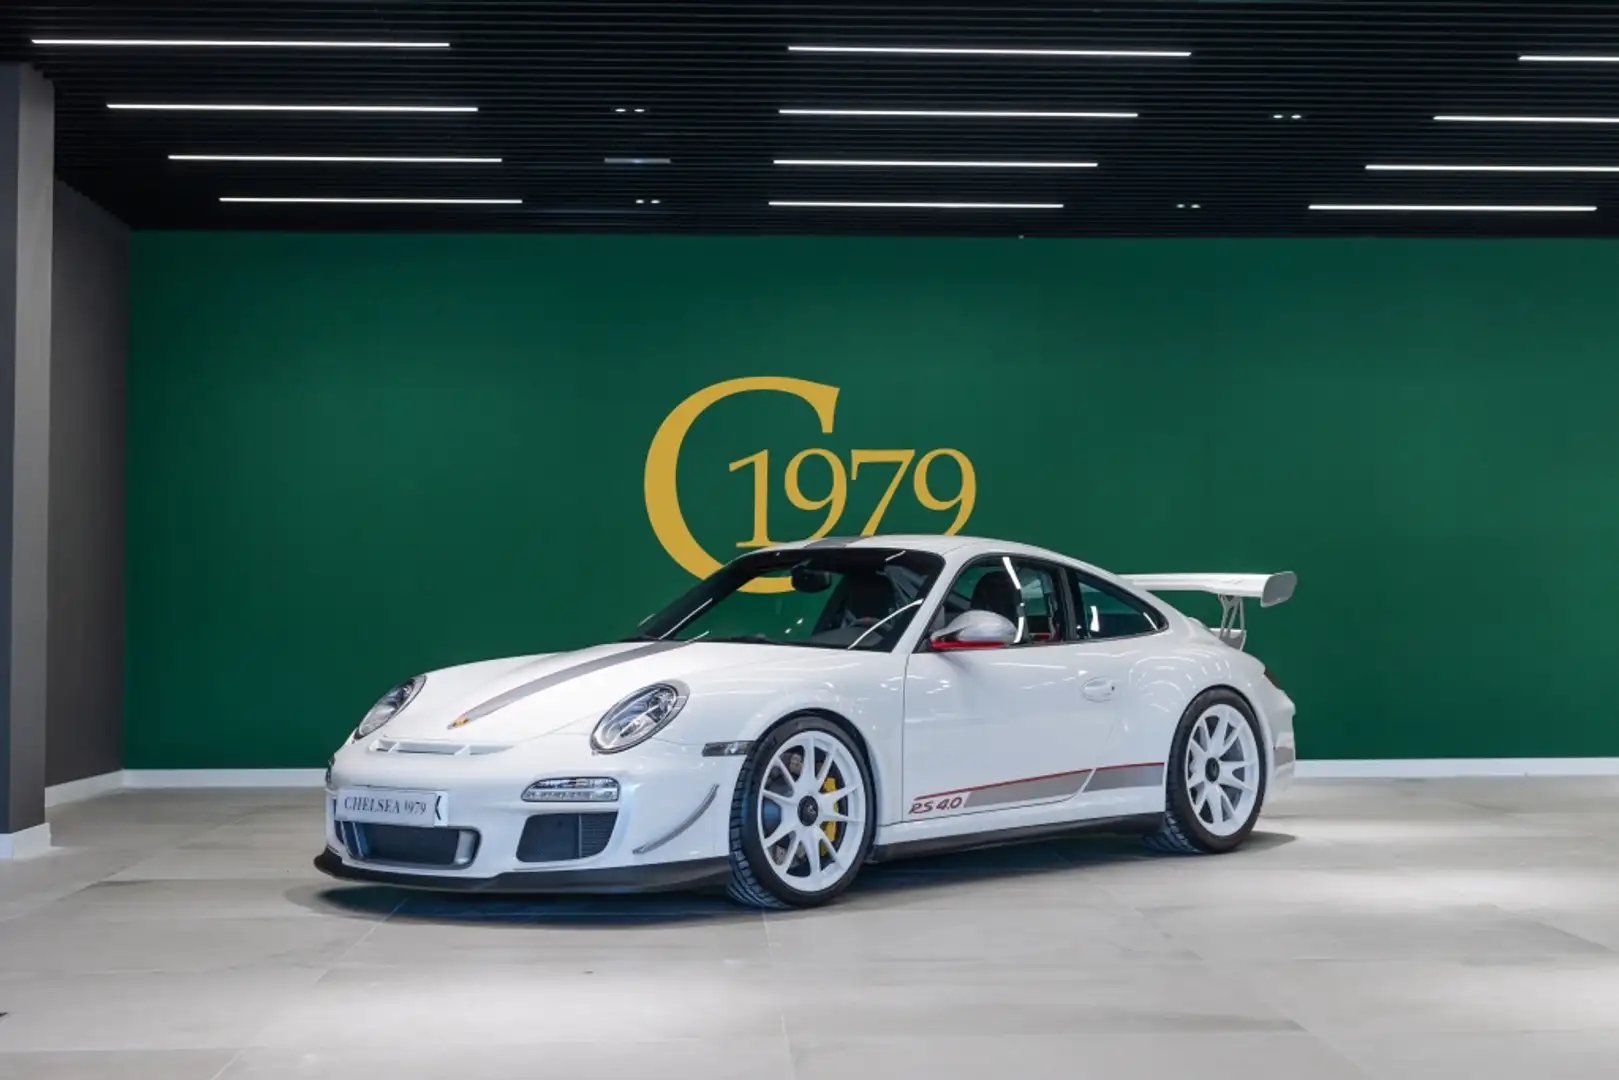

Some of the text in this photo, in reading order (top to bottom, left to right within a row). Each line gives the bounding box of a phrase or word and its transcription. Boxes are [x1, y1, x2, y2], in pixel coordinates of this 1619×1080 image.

[644, 376, 976, 593] C 1979
[344, 796, 427, 815] CHELSEA 1979
[908, 797, 963, 814] RS 4.0
